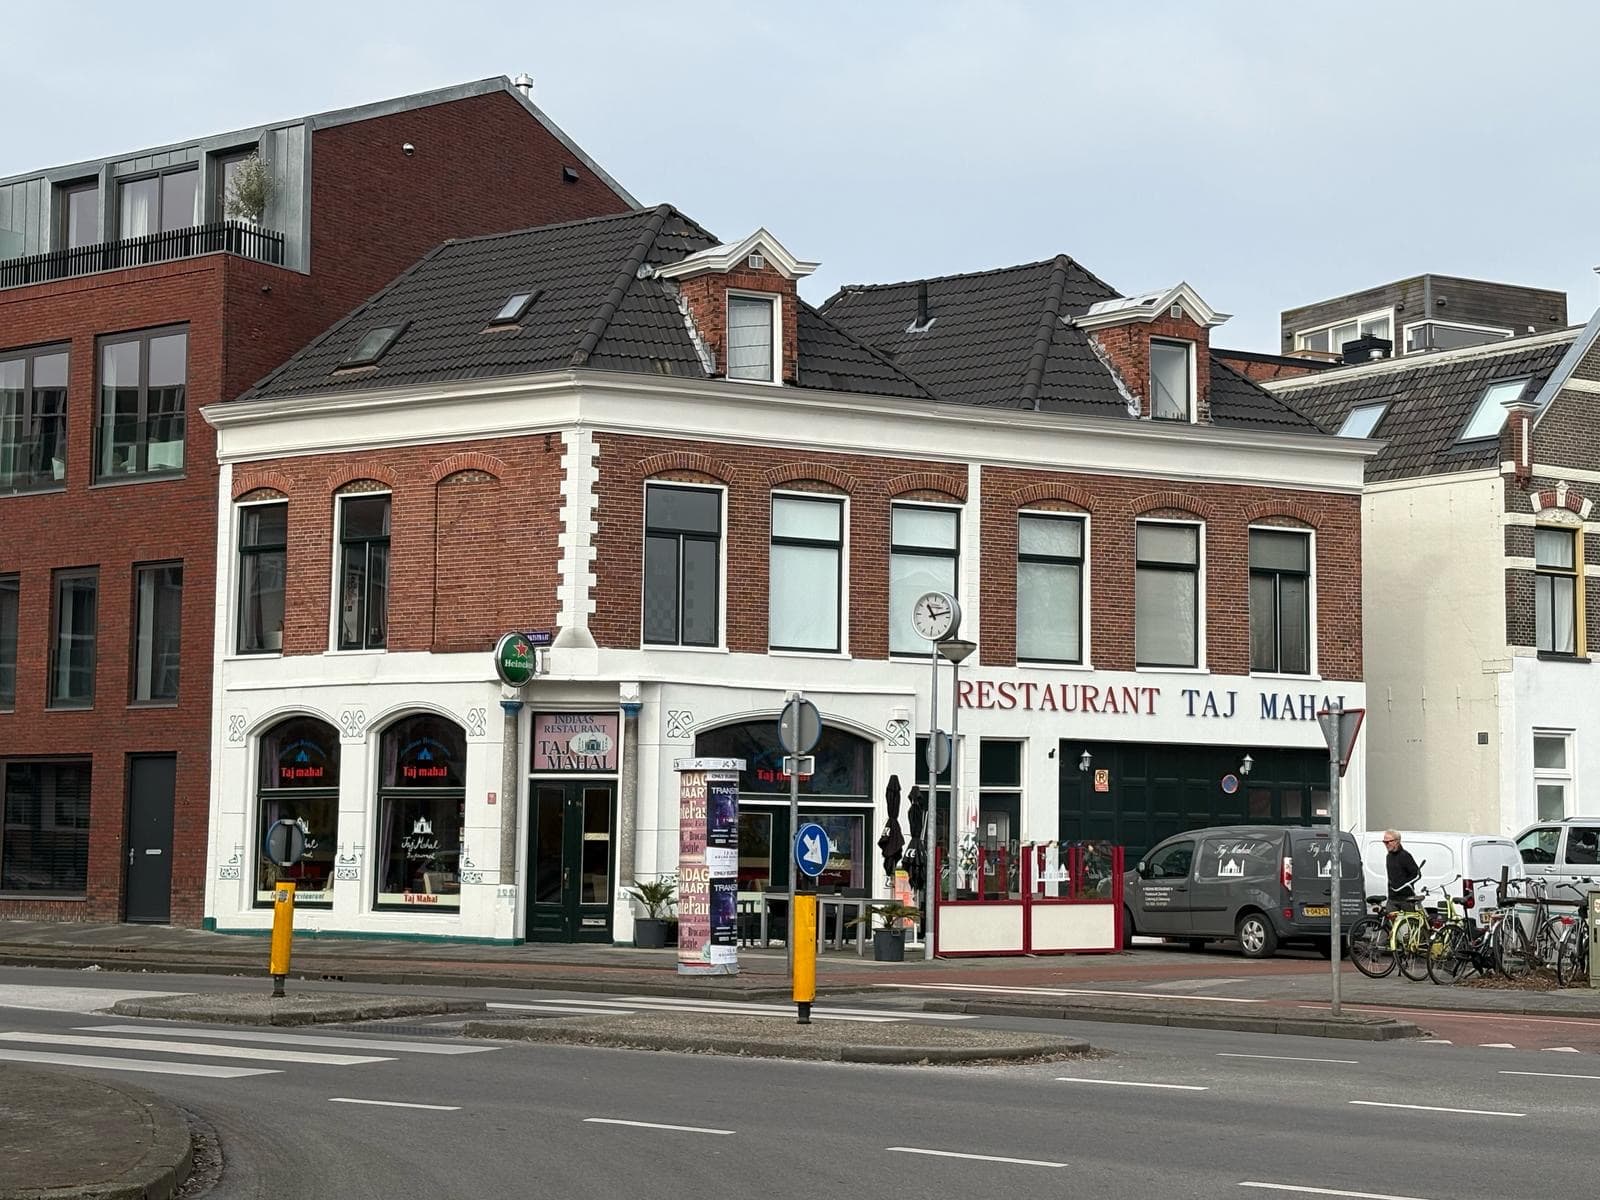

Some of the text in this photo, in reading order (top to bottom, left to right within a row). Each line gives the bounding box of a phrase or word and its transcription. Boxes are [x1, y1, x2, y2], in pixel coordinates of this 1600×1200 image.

[957, 680, 1161, 715] RESTAURANT
[1182, 689, 1238, 718] TAJ
[544, 725, 607, 733] RESTAURANT
[539, 740, 571, 755] TAJ
[547, 755, 612, 769] MAHAL
[281, 767, 295, 779] Taj
[403, 766, 417, 779] Taj
